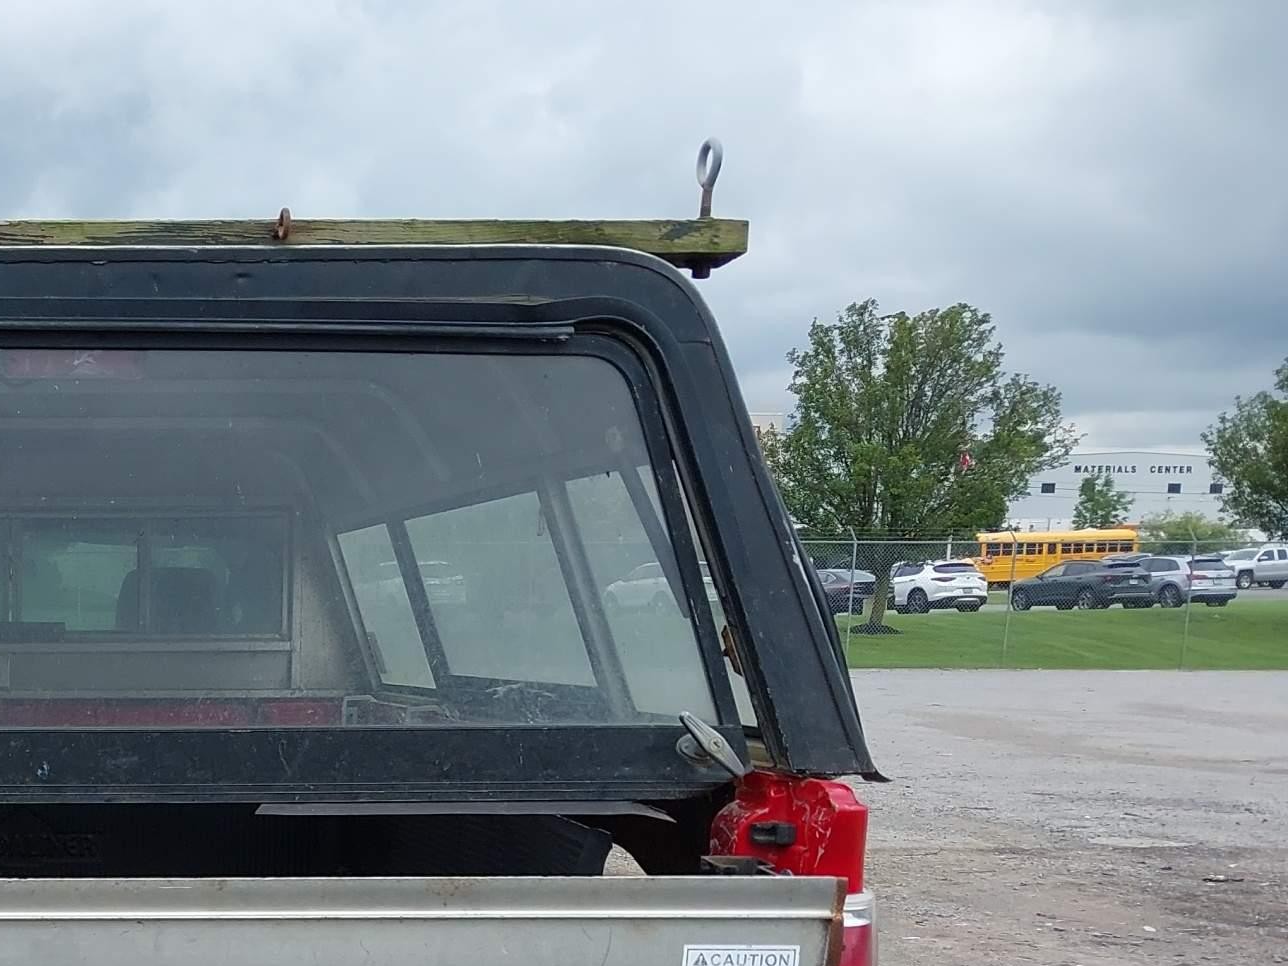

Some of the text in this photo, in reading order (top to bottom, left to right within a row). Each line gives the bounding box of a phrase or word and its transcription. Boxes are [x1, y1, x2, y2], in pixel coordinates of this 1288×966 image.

[1074, 465, 1193, 473] MATERIALS CENTER
[710, 953, 791, 966] CAUTION
